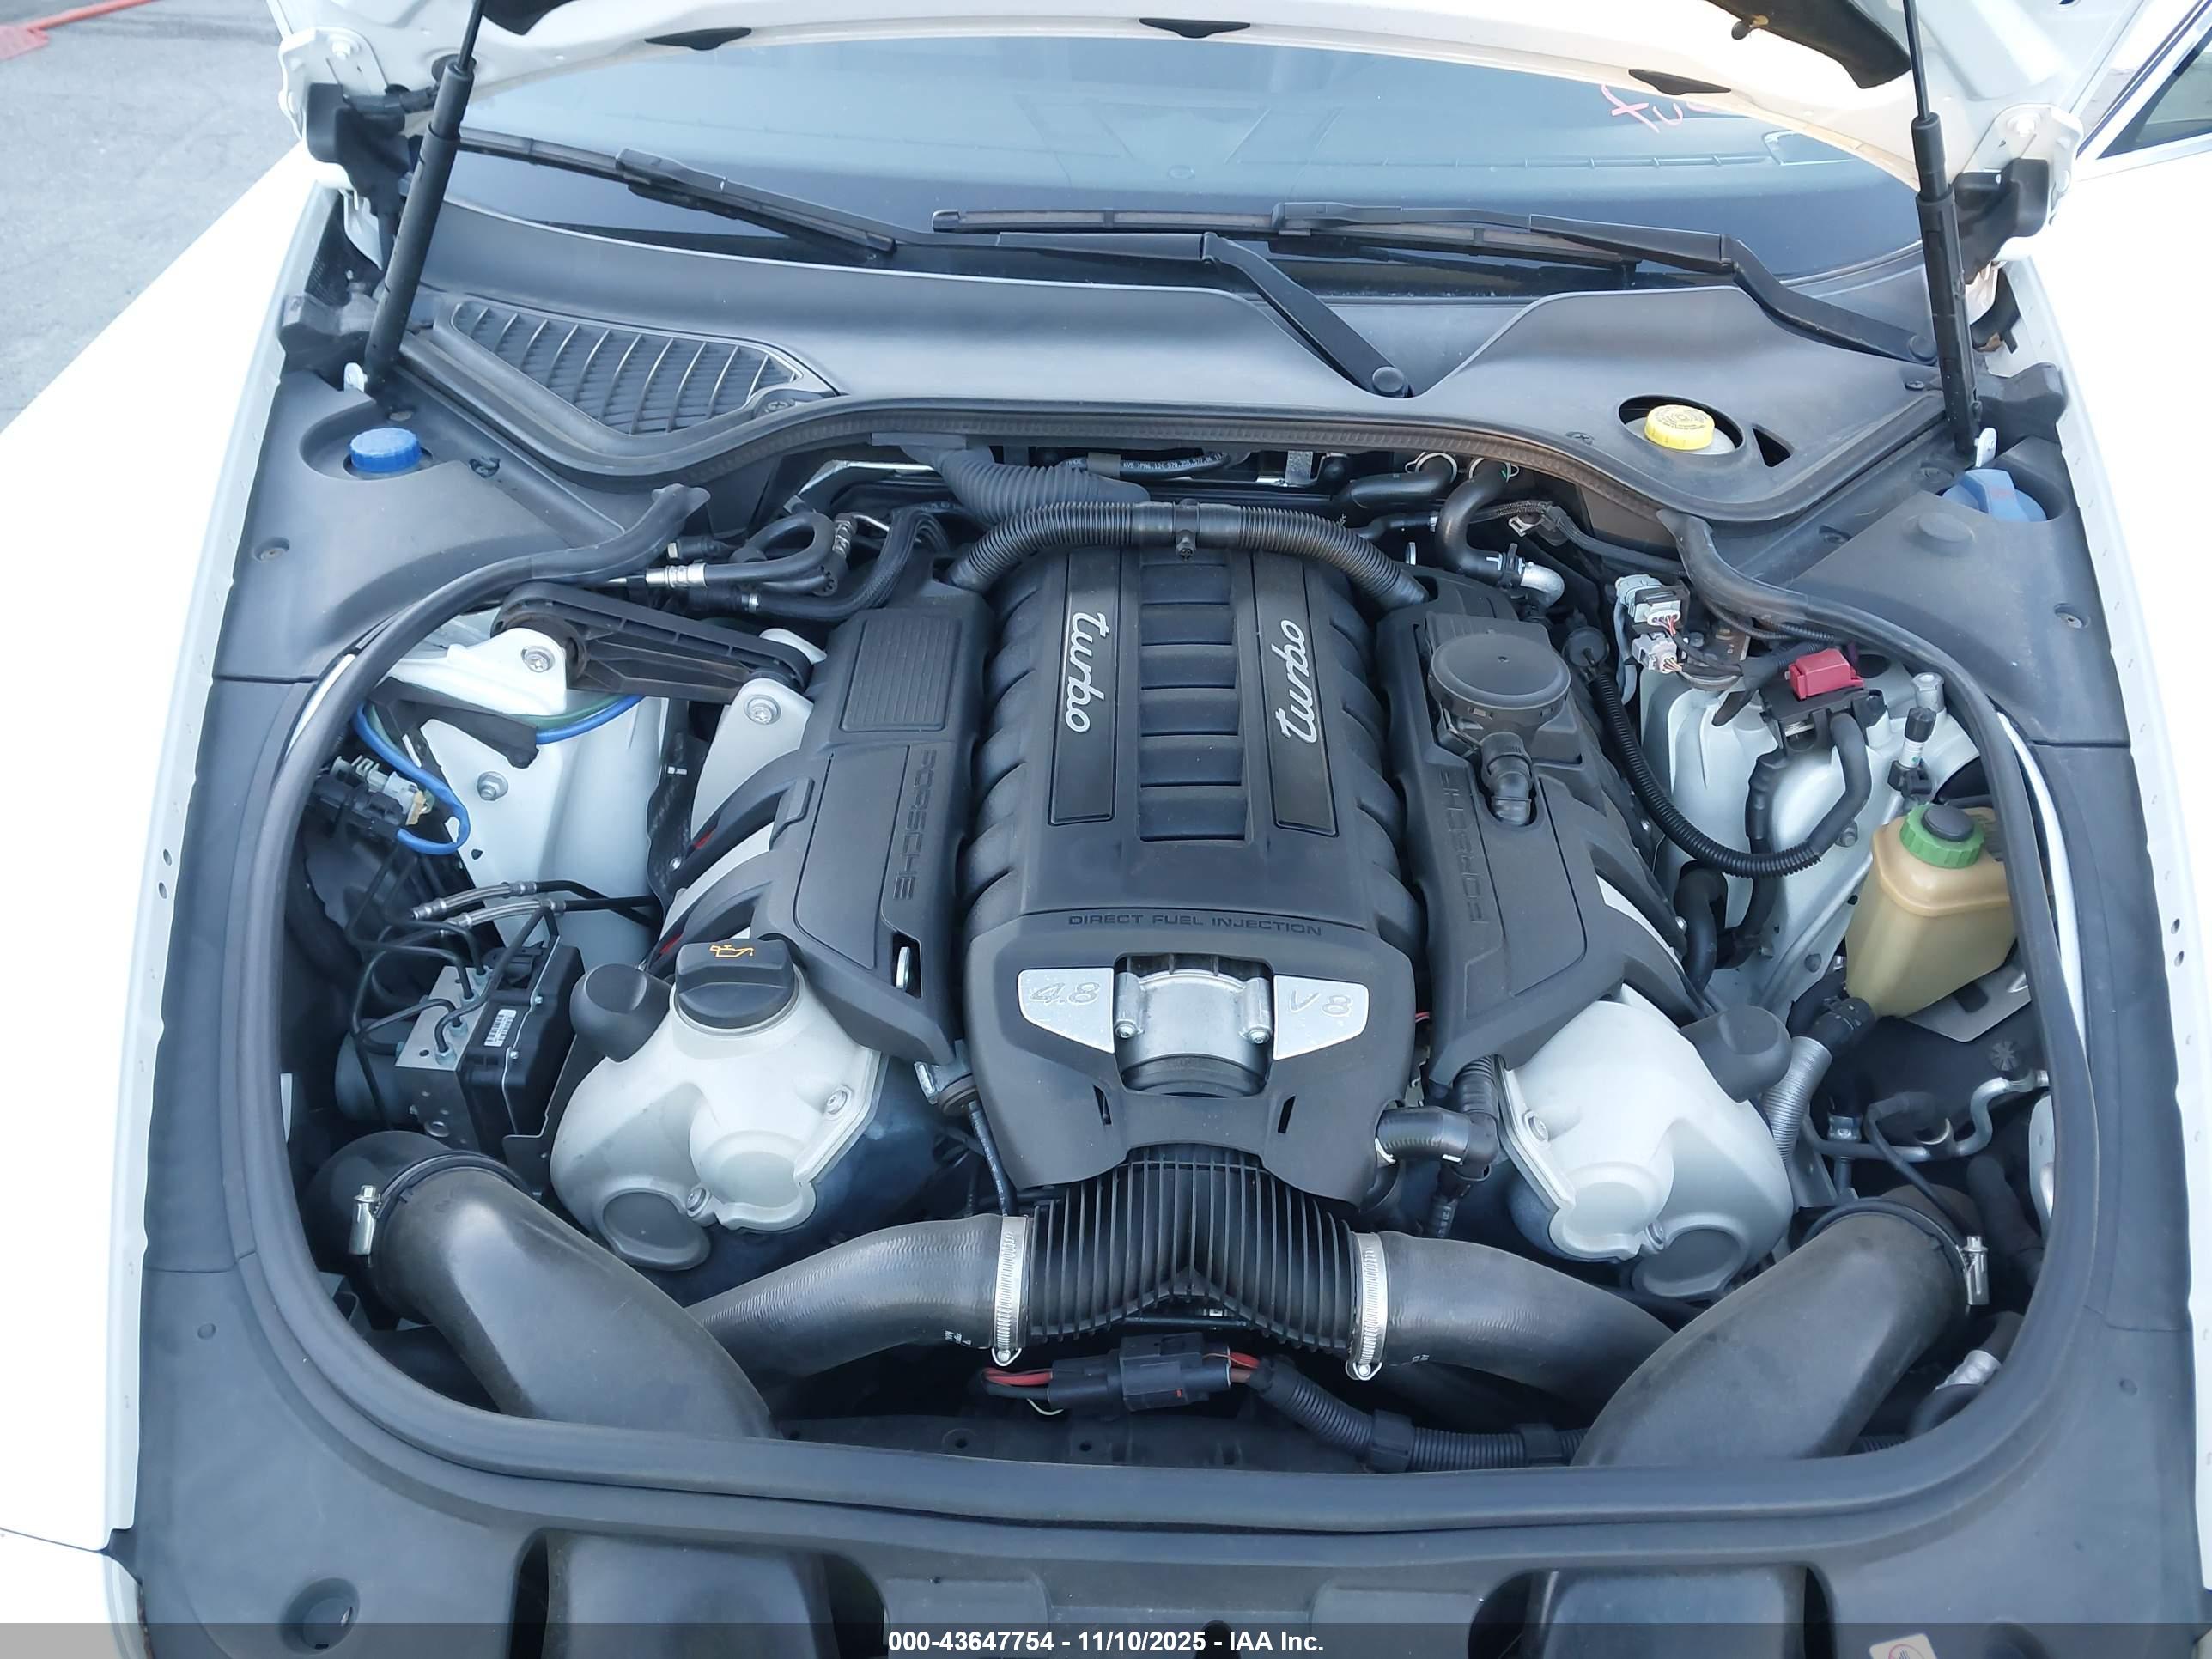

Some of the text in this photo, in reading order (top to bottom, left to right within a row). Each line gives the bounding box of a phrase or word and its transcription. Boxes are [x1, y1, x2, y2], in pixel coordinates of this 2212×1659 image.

[1065, 612, 1109, 732] turbo
[1271, 619, 1317, 743] turbo
[893, 749, 937, 900] PORSCHE
[1440, 769, 1490, 924] PORSCHE
[1068, 914, 1322, 937] DIRECT FUEL INJECTION
[1030, 981, 1102, 1006] 4.8
